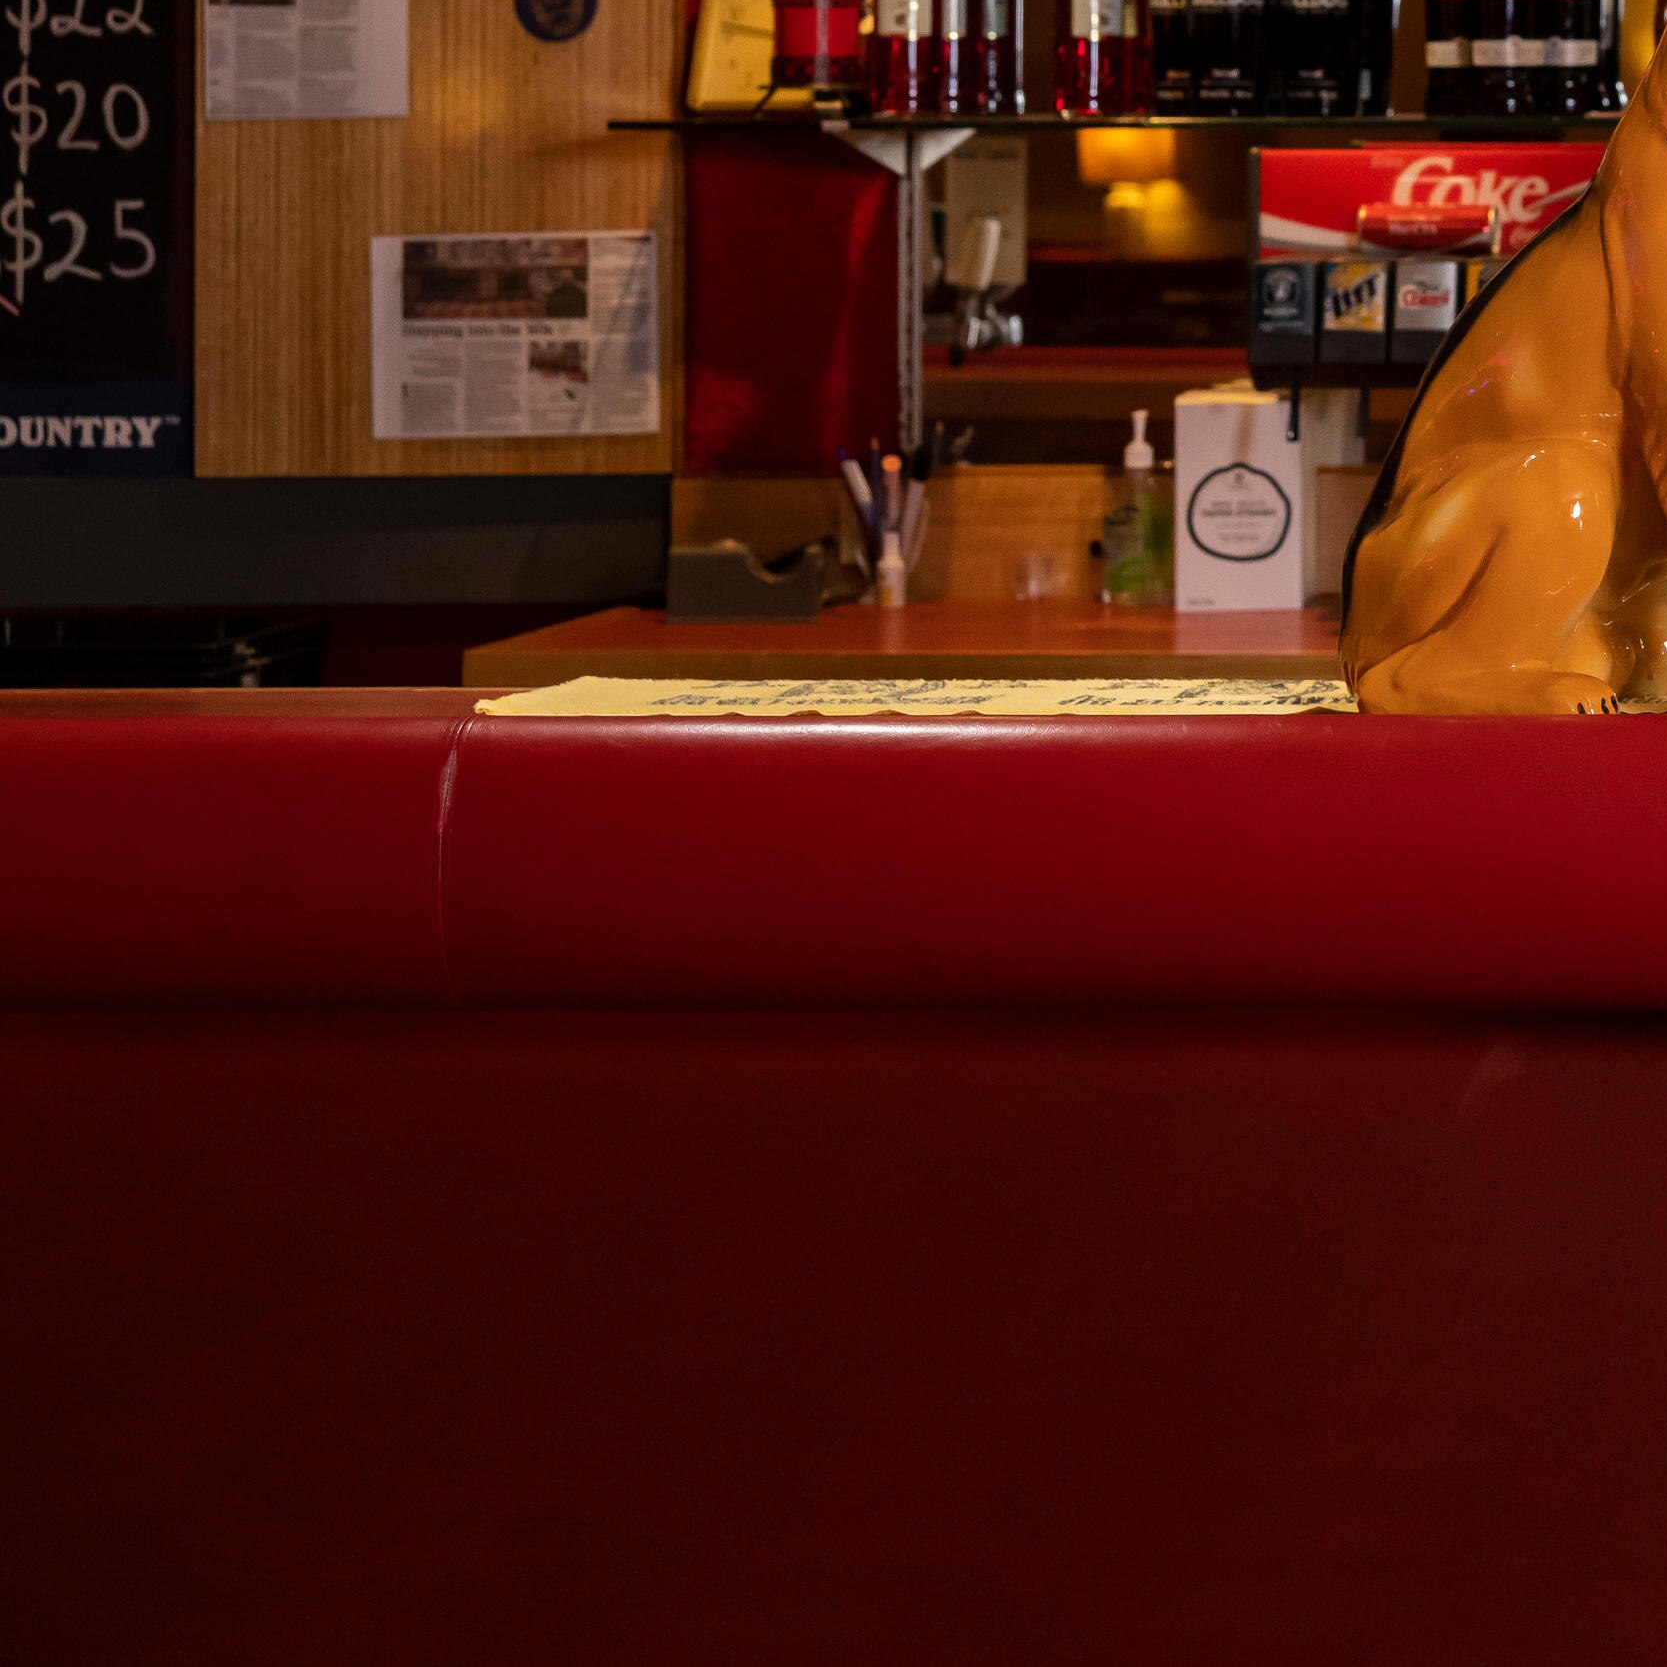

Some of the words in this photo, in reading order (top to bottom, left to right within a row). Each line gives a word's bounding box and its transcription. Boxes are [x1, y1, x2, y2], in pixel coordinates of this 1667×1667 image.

[2, 61, 151, 176] $20
[1391, 156, 1549, 224] Coke
[1, 180, 156, 304] $25
[0, 415, 160, 449] OUNTRY
